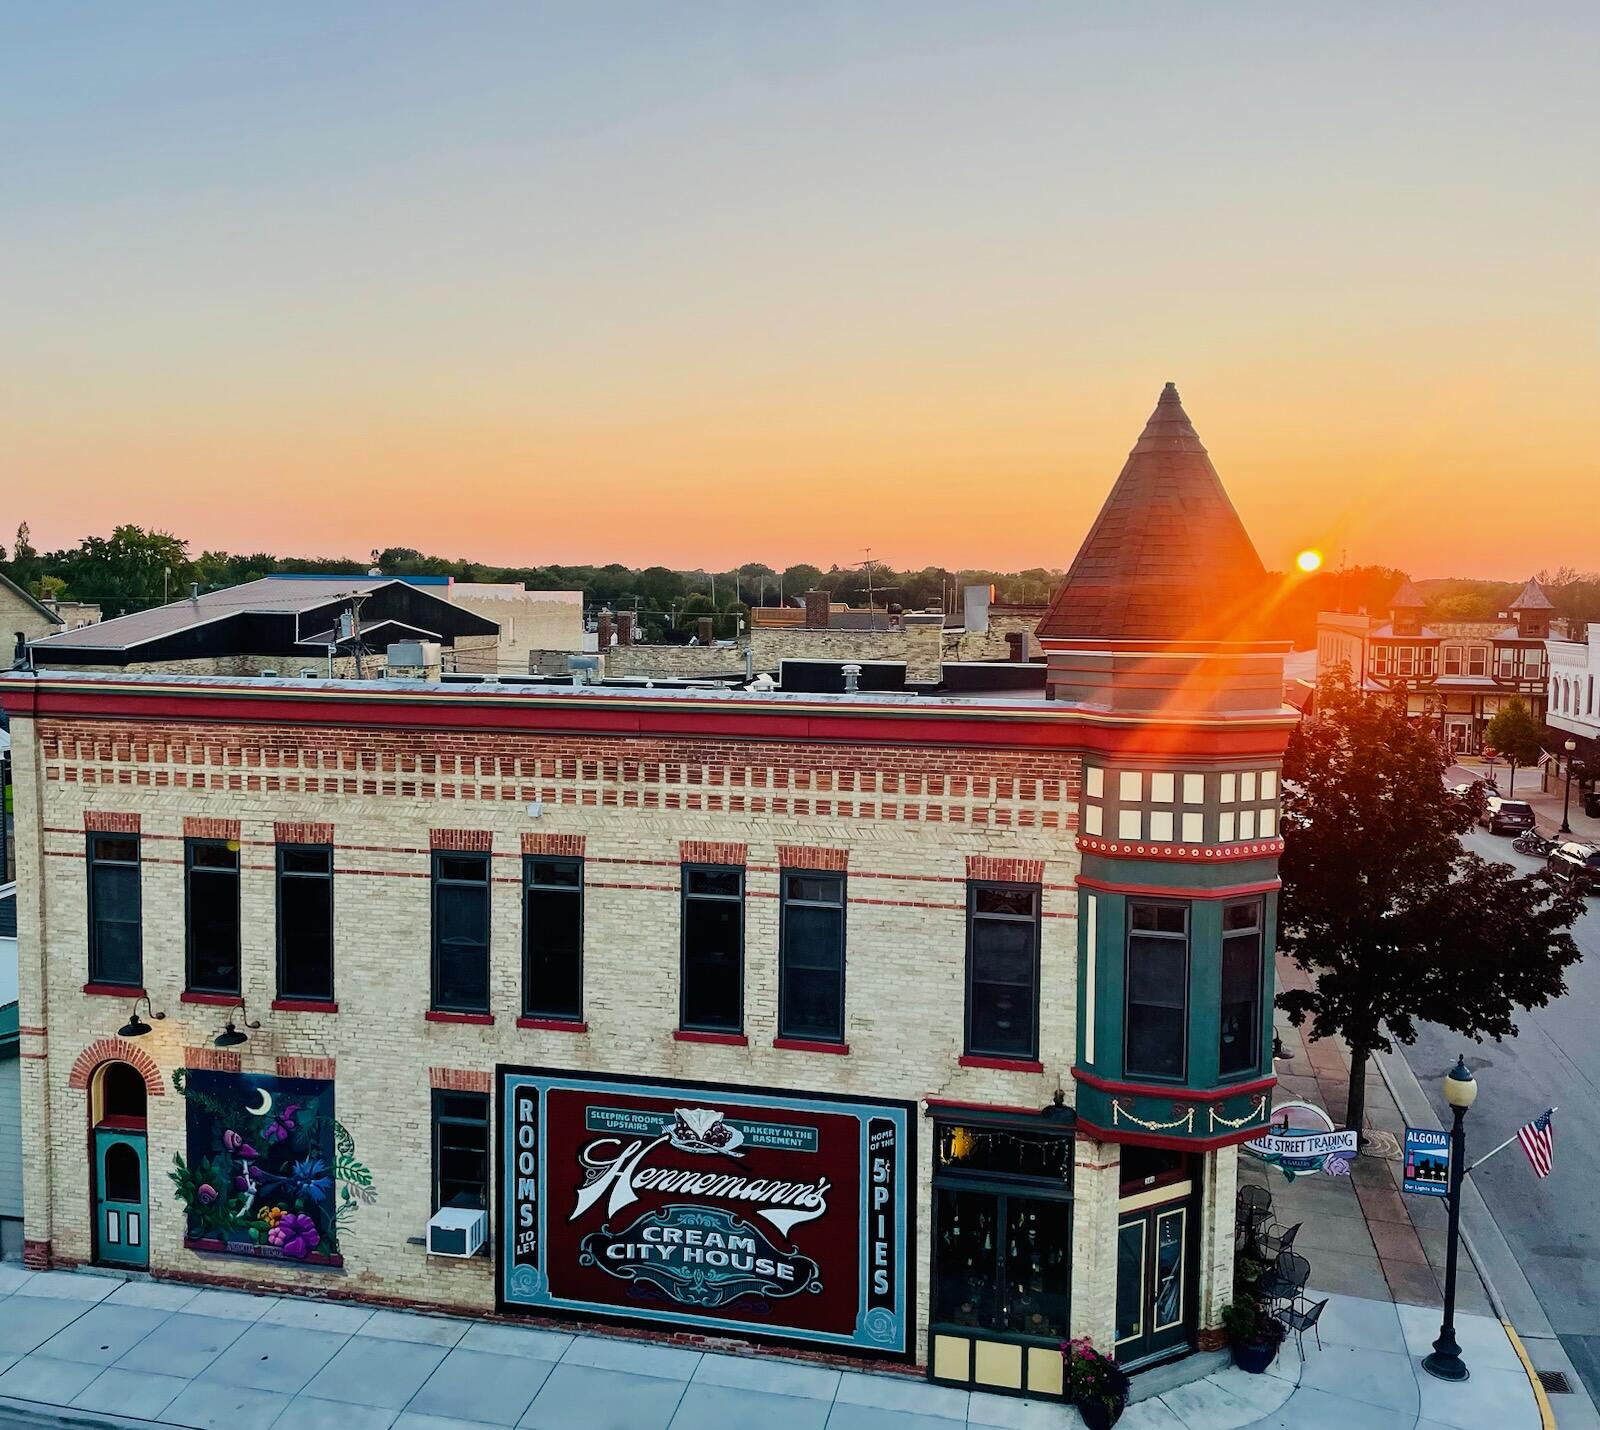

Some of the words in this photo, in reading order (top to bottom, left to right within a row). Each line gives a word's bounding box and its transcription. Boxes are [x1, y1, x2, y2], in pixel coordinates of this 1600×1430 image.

[591, 1110, 630, 1121] SLEEPING
[631, 1114, 664, 1125] ROOMS
[606, 1120, 648, 1131] UPSTAIRS
[743, 1125, 781, 1136] BAKERY
[783, 1129, 793, 1138] IN
[795, 1130, 813, 1140] THE
[752, 1134, 803, 1146] BASEMENT
[871, 1129, 893, 1142] HOME
[1250, 1136, 1273, 1150] EELE
[1275, 1140, 1306, 1153] STREET
[1307, 1133, 1353, 1152] TRADING
[1407, 1131, 1447, 1146] ALGOMA
[870, 1142, 880, 1151] OF
[881, 1138, 895, 1148] THE
[518, 1098, 536, 1227] ROOMS
[569, 1134, 831, 1238] Hennemann's
[519, 1230, 535, 1243] TO
[642, 1226, 756, 1254] CREAM
[873, 1186, 890, 1295] PIES
[517, 1241, 537, 1255] LET
[606, 1243, 675, 1260] CITY
[683, 1246, 795, 1281] HOUSE
